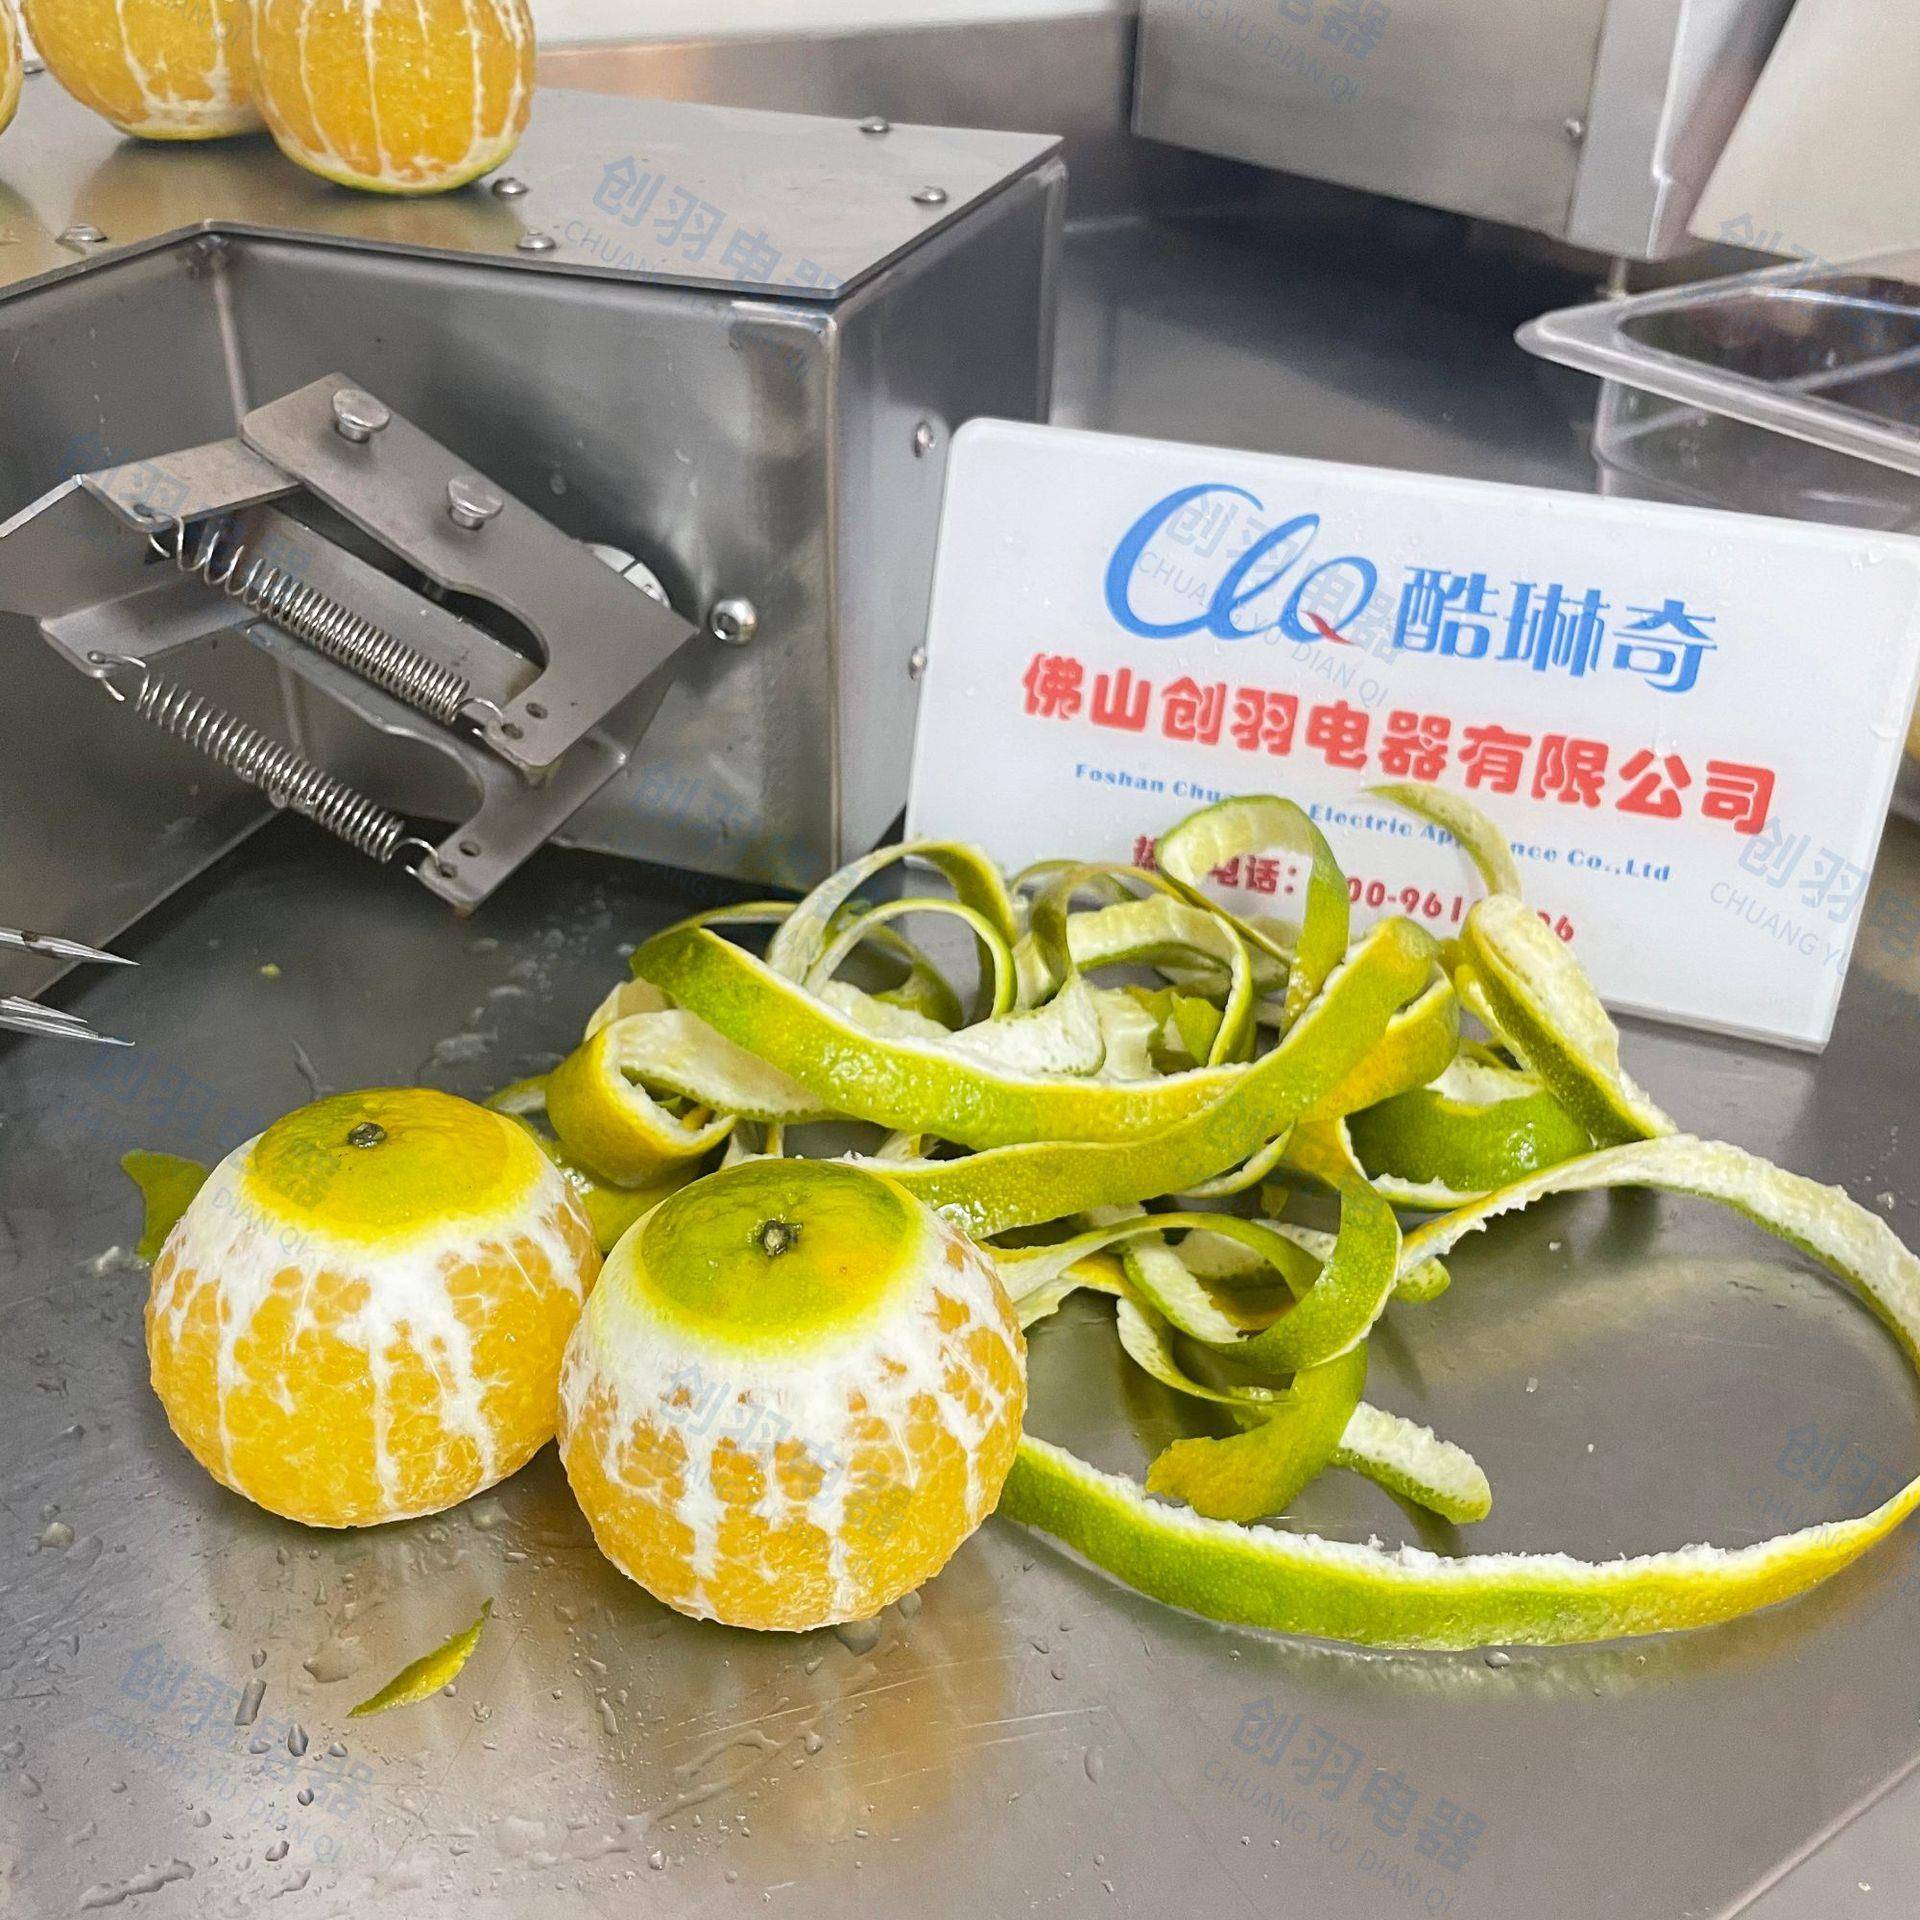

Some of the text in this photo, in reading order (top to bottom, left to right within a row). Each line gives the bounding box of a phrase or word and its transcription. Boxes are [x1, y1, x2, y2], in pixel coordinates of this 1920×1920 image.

[1393, 565, 1717, 693] 酷琳奇
[1022, 652, 1776, 835] 佛山创羽电器有限公司
[1075, 763, 1165, 793] Foshan
[1308, 804, 1411, 838] Electric
